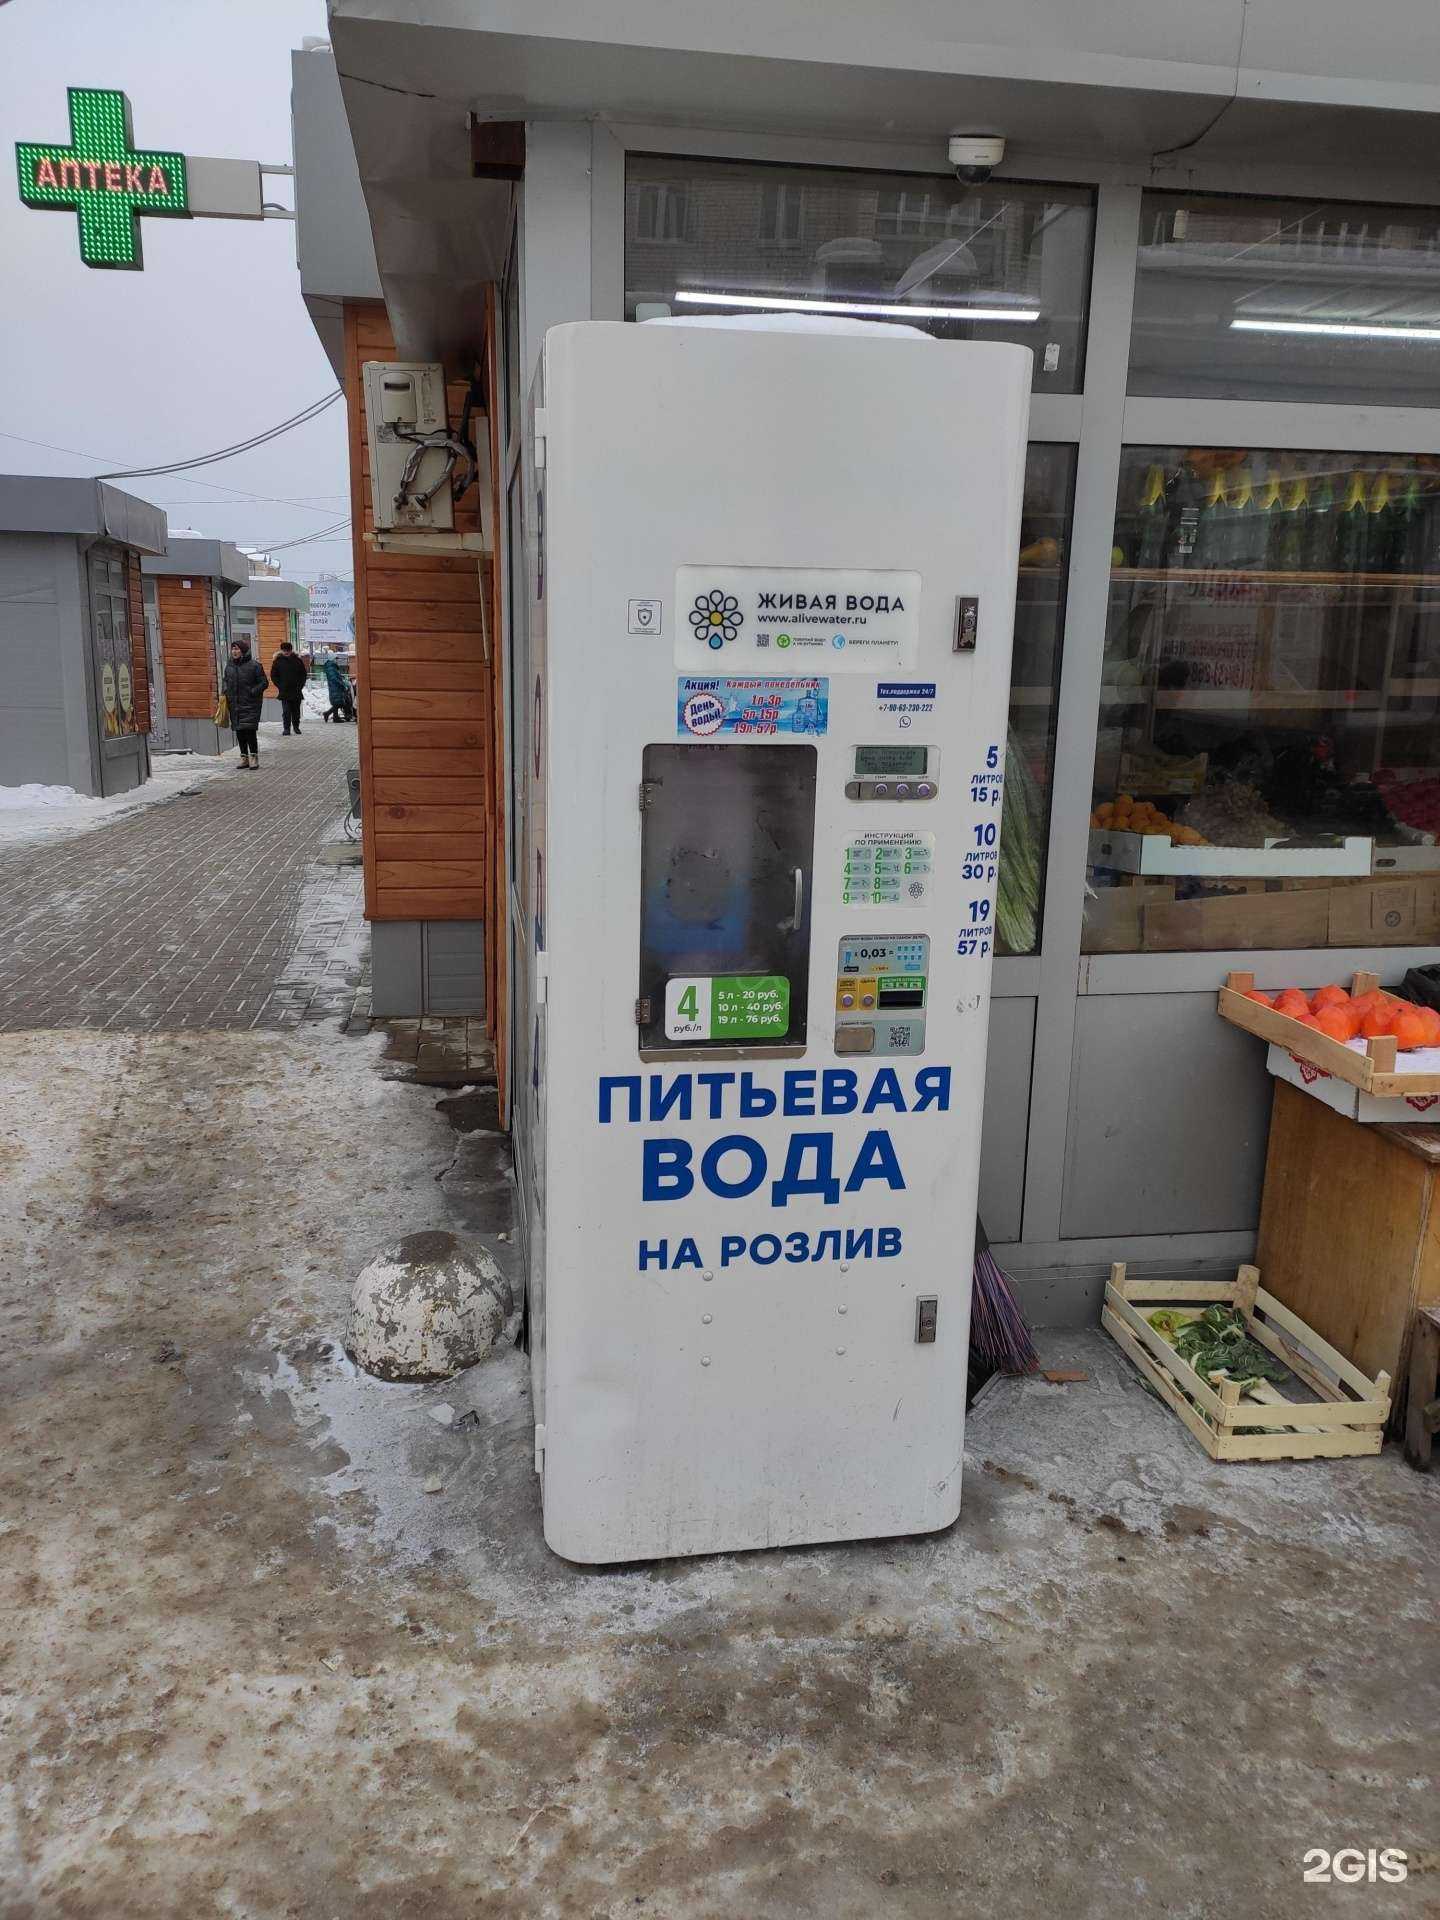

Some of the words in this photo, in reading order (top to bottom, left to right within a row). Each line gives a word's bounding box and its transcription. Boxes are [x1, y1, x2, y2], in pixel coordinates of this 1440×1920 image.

[37, 156, 169, 195] АПТЕКА
[758, 593, 837, 610] ЖИВАЯ
[846, 595, 905, 613] ВОДА
[757, 613, 868, 625] www.alivewater.ru
[685, 680, 720, 690] Акция!
[690, 700, 715, 717] День
[691, 708, 721, 727] воды!
[986, 745, 999, 769] 5
[971, 774, 1003, 784] ЛИТРОВ
[970, 787, 988, 802] 15
[991, 789, 1001, 807] р.
[974, 823, 996, 846] 10
[844, 848, 850, 860] 1
[875, 848, 883, 860] 2
[905, 848, 912, 860] 3
[964, 851, 998, 862] ЛИТРОВ
[843, 863, 851, 875] 4
[874, 863, 882, 875] 5
[904, 862, 912, 875] 6
[961, 864, 983, 880] 30
[987, 868, 997, 883] р.
[843, 877, 850, 890] 7
[873, 877, 881, 890] 8
[842, 892, 850, 904] 9
[871, 891, 881, 904] 10
[968, 900, 990, 923] 19
[958, 926, 992, 938] ЛИТРОВ
[860, 948, 886, 959] 0,03
[956, 940, 978, 956] 57
[981, 942, 991, 958] р.
[718, 992, 725, 1000] 5
[742, 990, 755, 999] 20
[757, 990, 779, 1001] руб.
[677, 985, 699, 1022] 4
[718, 1004, 729, 1012] 10
[746, 1002, 760, 1011] 40
[762, 1001, 784, 1013] руб.
[717, 1016, 728, 1024] 19
[746, 1015, 758, 1023] 76
[760, 1013, 782, 1025] руб.
[673, 1023, 702, 1033] руб./л
[598, 1066, 951, 1124] ПИТЬЕВАЯ
[642, 1130, 906, 1207] ВОДА
[638, 1238, 704, 1271] НА
[720, 1227, 902, 1267] РОЗЛИВ
